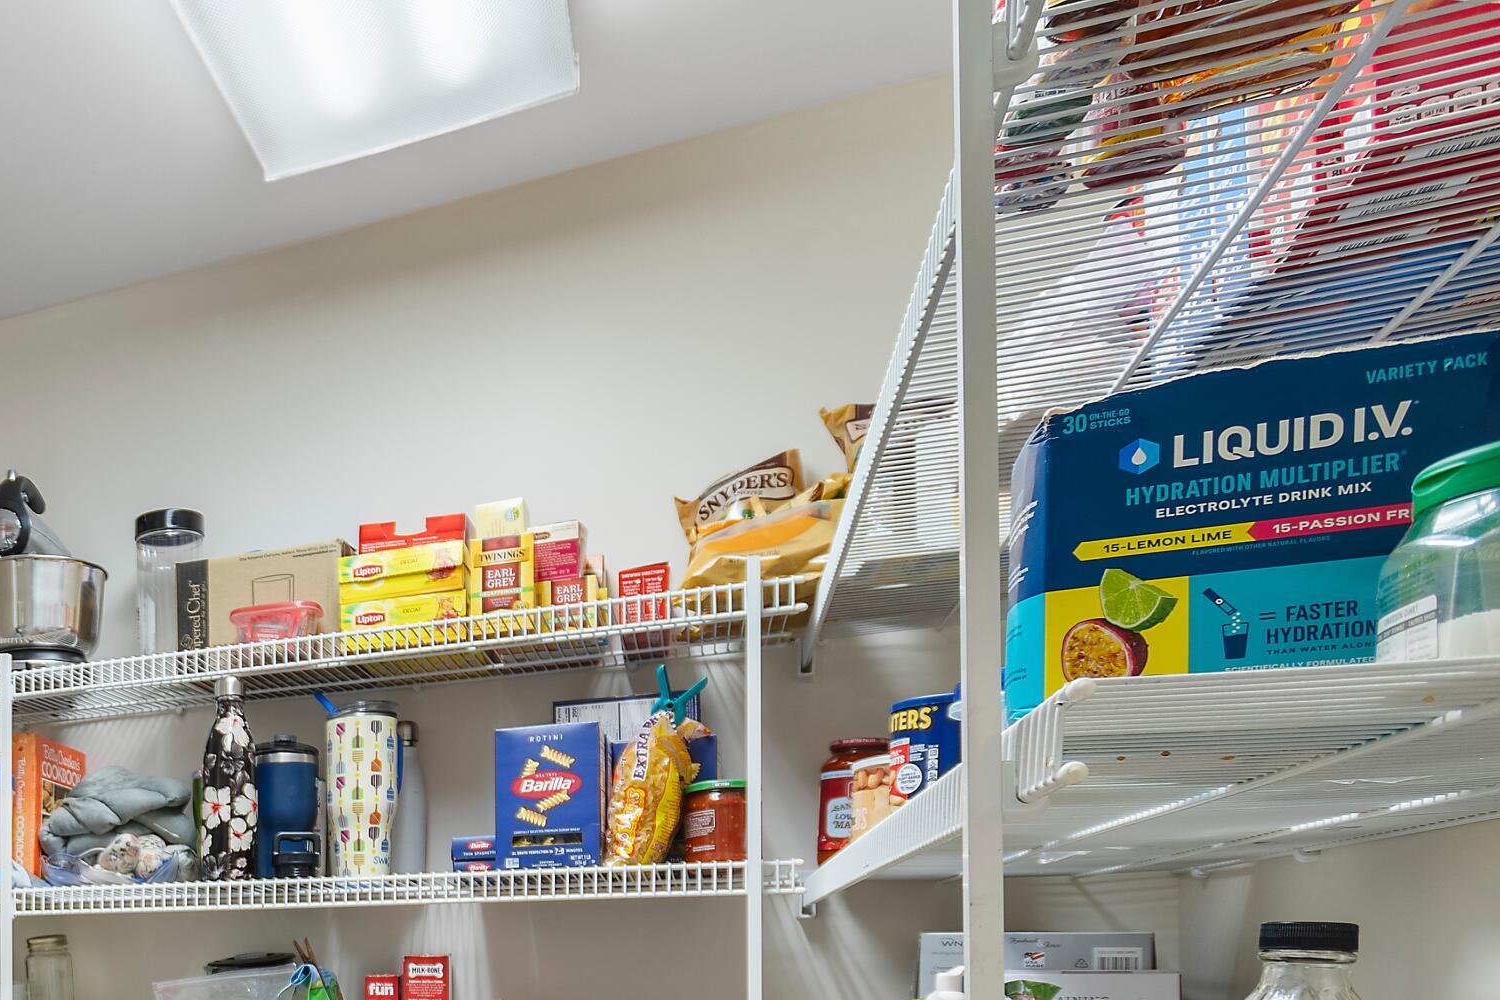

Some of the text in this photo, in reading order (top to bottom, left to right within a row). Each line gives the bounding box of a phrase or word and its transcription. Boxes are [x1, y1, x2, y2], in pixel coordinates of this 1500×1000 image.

[1366, 352, 1488, 384] VARIETY PACK
[1062, 408, 1130, 434] 30 ON-THE-GO
[1090, 416, 1131, 430] STICKS
[1173, 400, 1413, 468] LIQUID I.V.
[1125, 456, 1399, 506] HYDRATION MULTIPLIER
[699, 472, 788, 520] SNYDER'S
[1155, 481, 1372, 519] ELECTROLYTE DRINK MIX
[1273, 507, 1410, 534] 15-PASSION FR
[1103, 530, 1232, 553] 15-LEMON LIME
[479, 550, 524, 561] TWININGS
[355, 566, 381, 576] Lipton
[487, 567, 515, 578] EARL
[487, 577, 516, 588] GREY
[556, 584, 583, 594] EARL
[557, 591, 583, 603] GREY
[1286, 599, 1358, 621] FASTER
[357, 613, 384, 624] Lipton
[1267, 620, 1376, 645] HYDRATION
[1267, 646, 1297, 655] THAN
[1301, 643, 1337, 652] WATER
[530, 734, 563, 742] ROTINI
[634, 732, 650, 780] EXTRA
[521, 777, 572, 792] Barilla
[369, 983, 394, 995] fun
